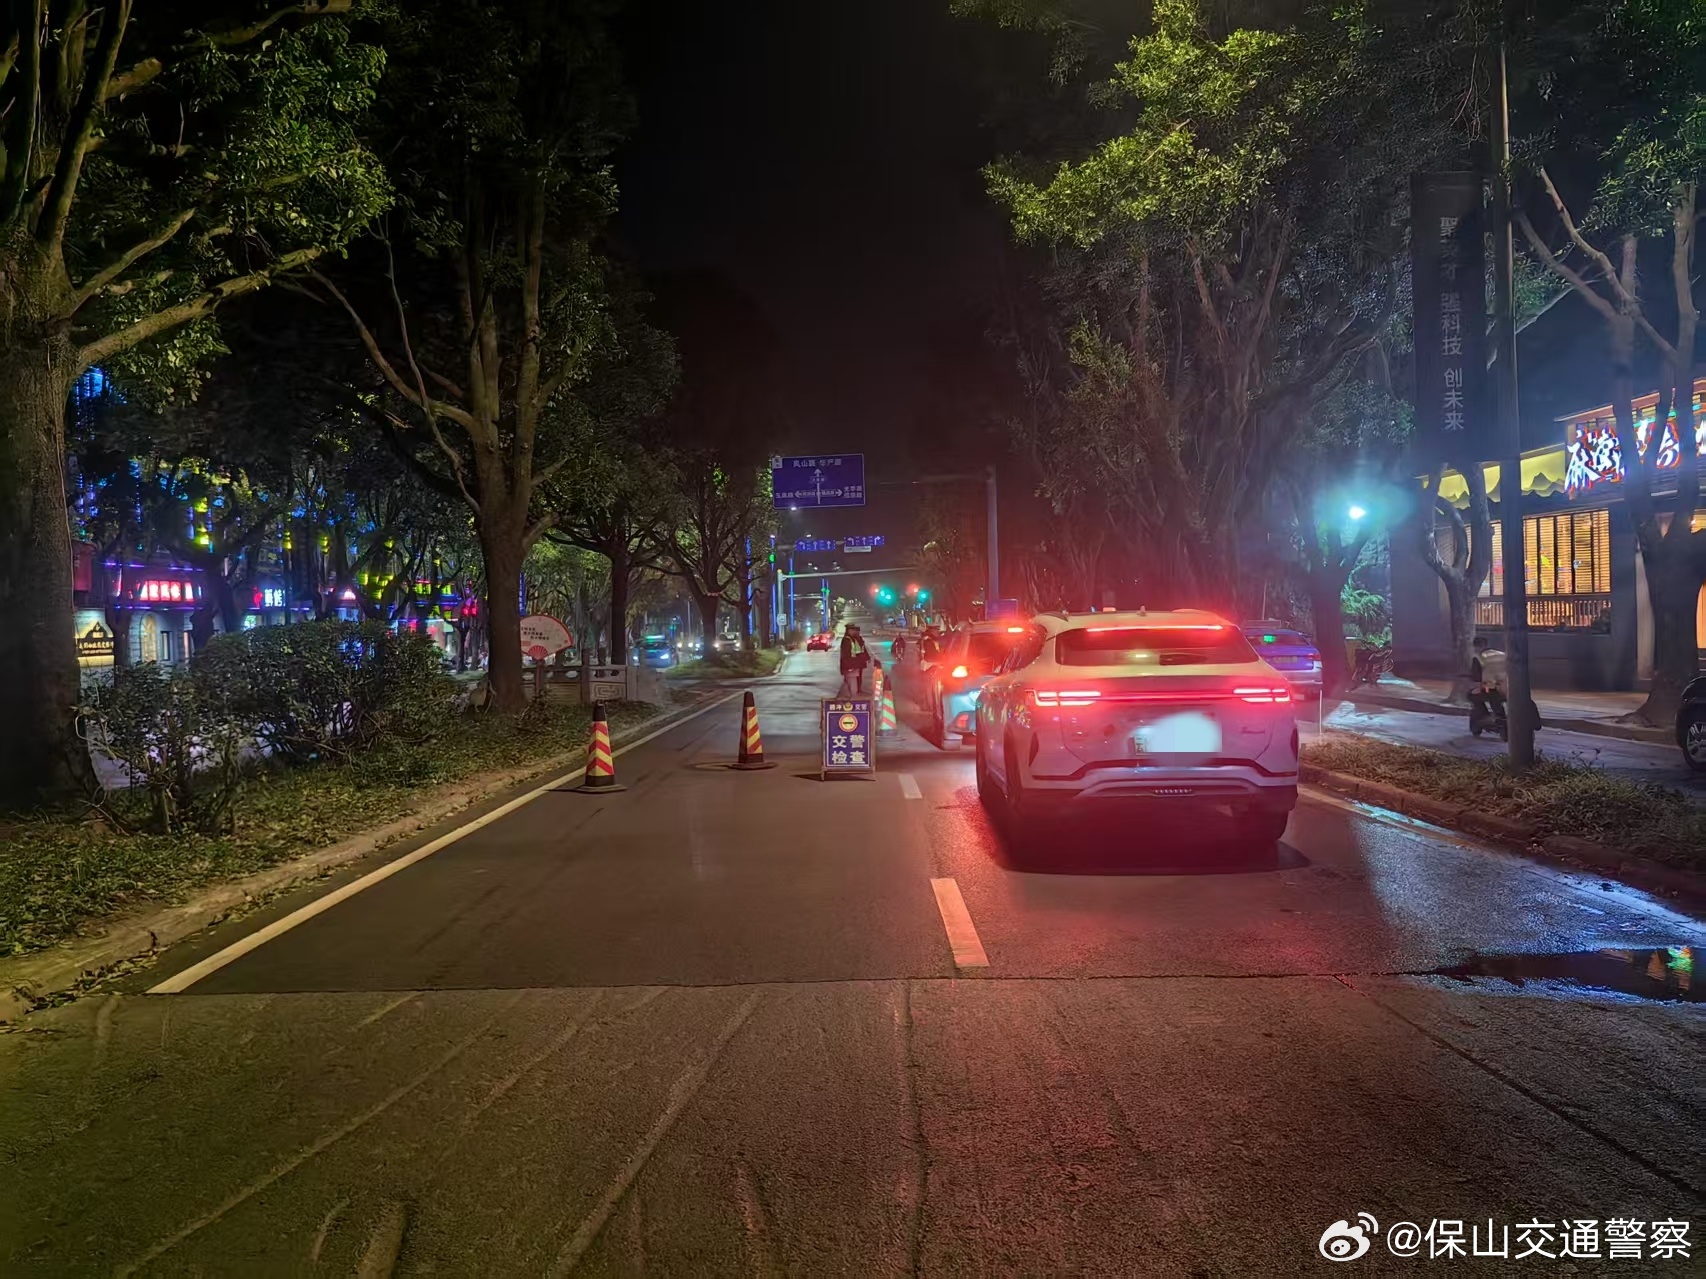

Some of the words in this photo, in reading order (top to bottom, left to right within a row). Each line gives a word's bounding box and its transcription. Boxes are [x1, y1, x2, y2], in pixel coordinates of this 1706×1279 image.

[1443, 367, 1465, 431] 创未来
[831, 734, 865, 749] 交警
[831, 750, 866, 764] 检查
